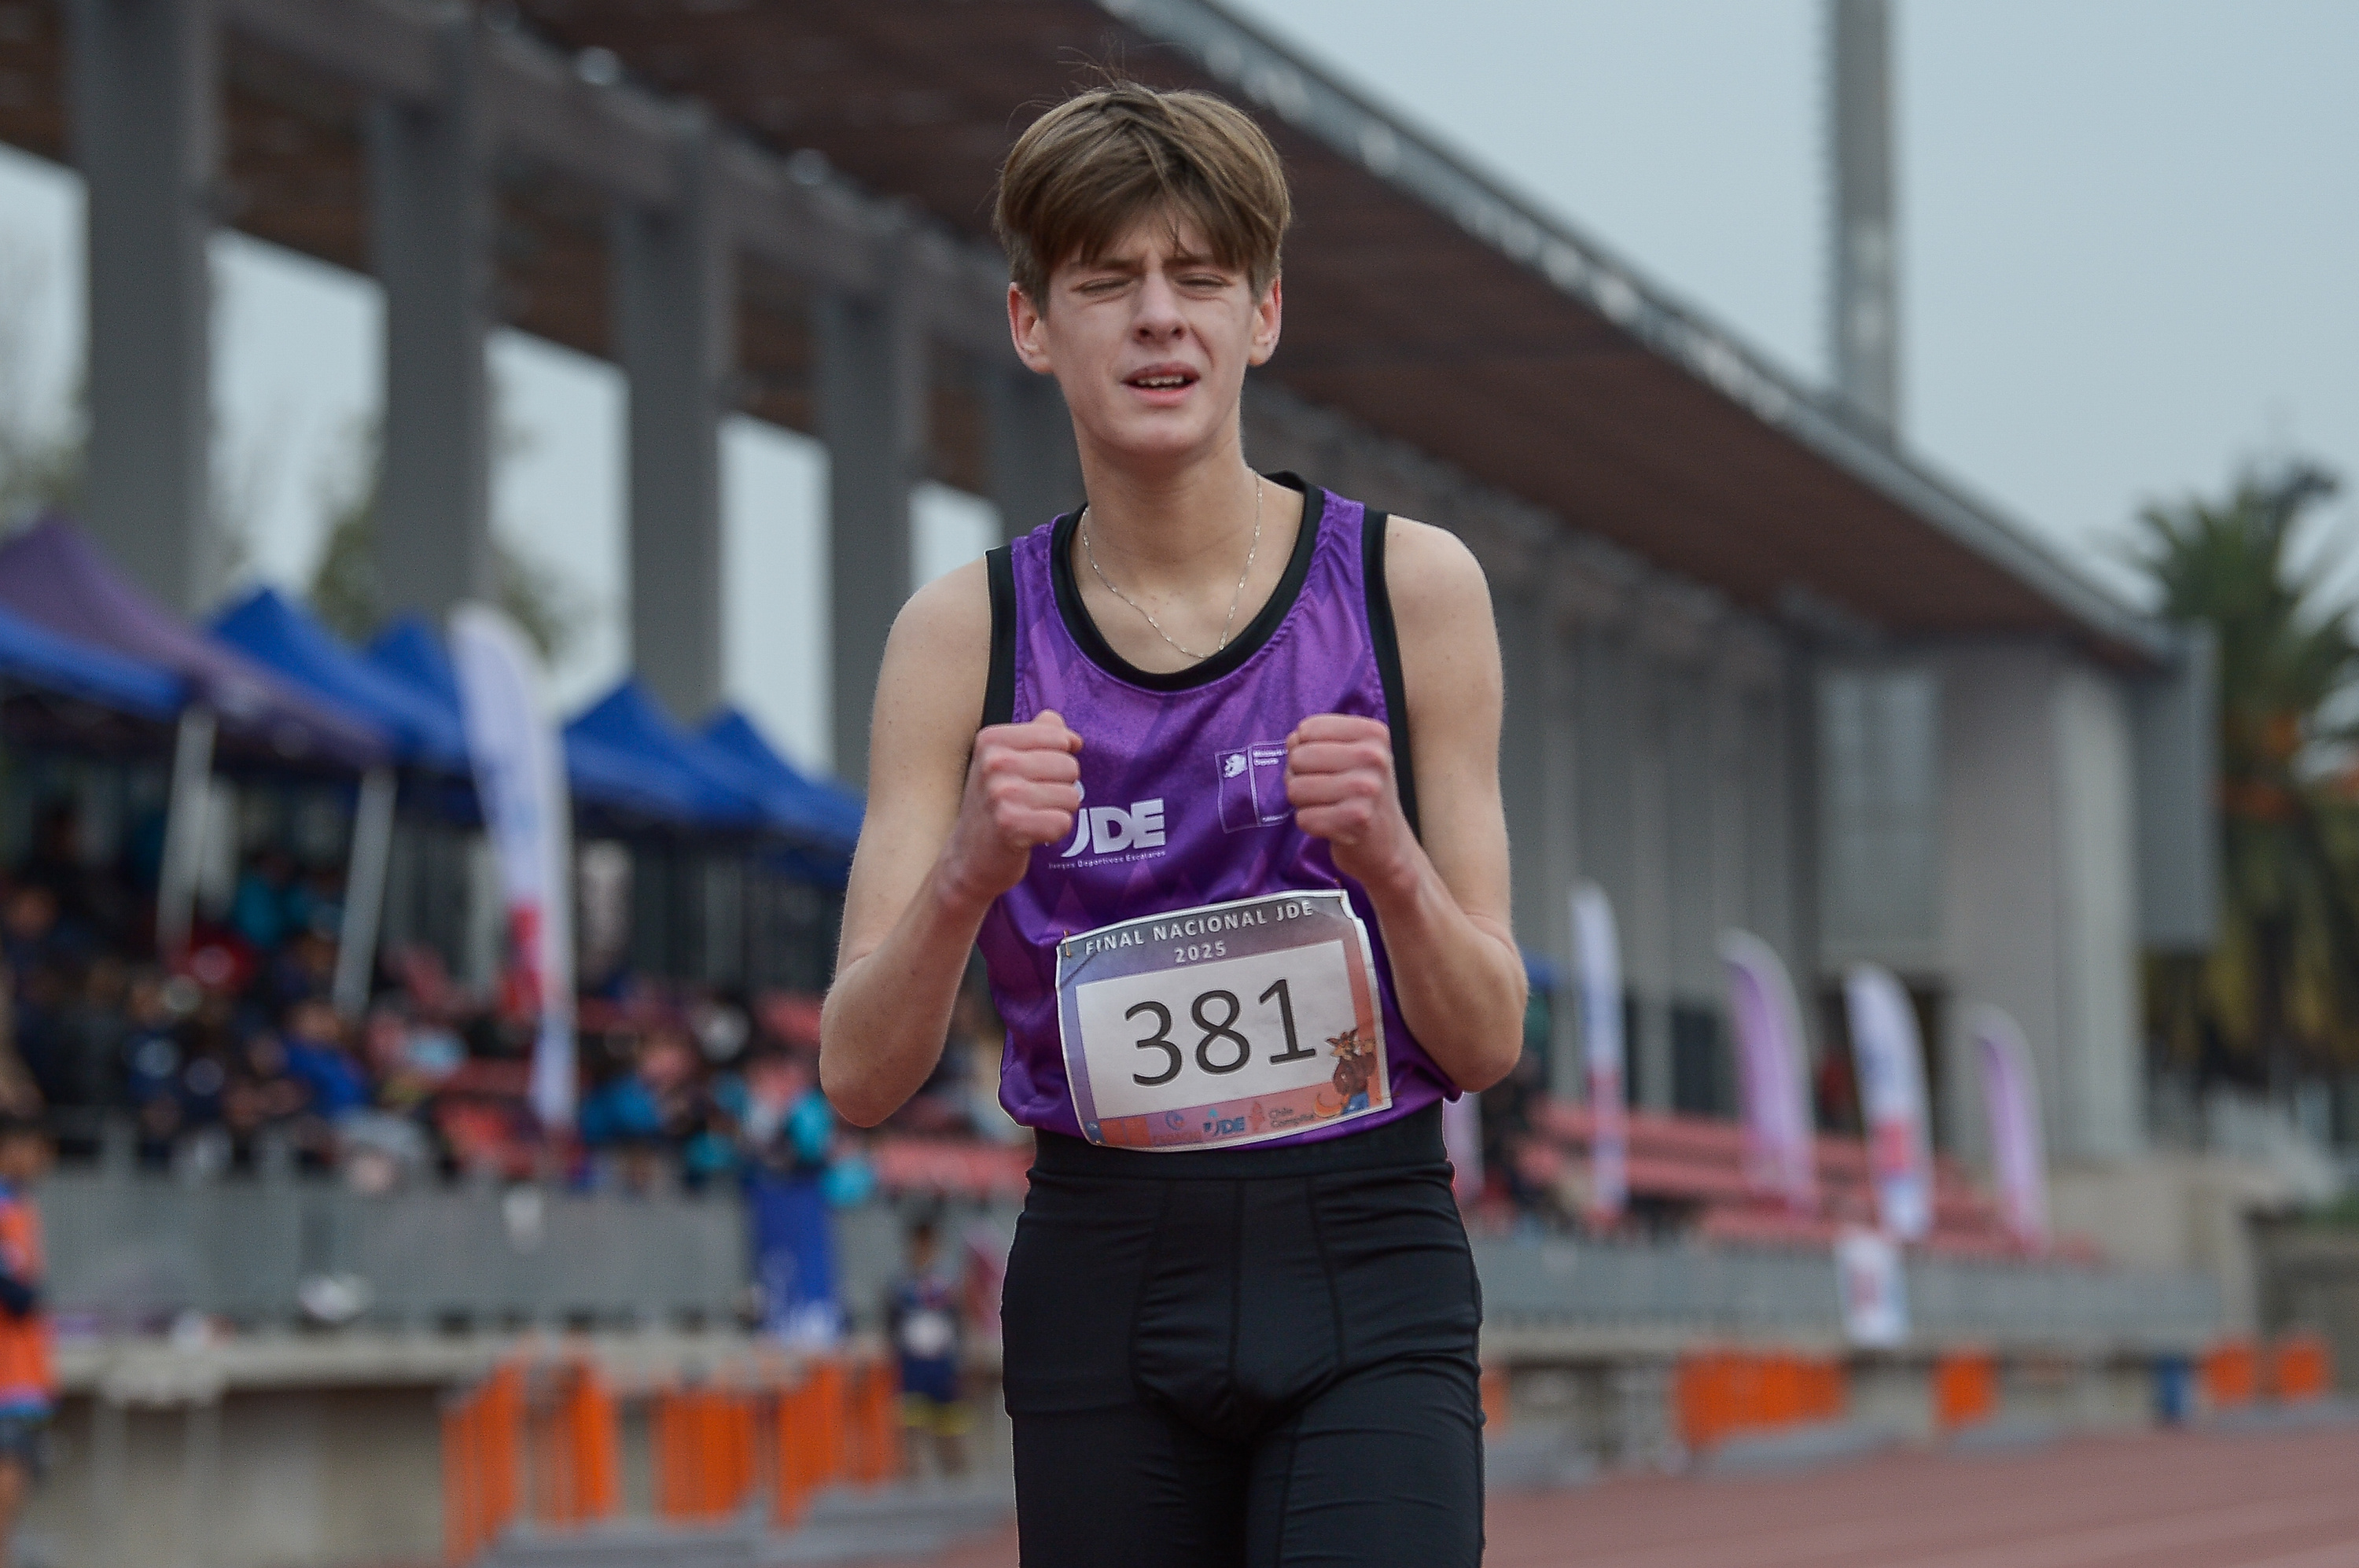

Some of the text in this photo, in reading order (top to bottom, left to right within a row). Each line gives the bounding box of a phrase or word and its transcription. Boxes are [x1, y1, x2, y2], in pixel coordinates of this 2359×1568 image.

[1061, 798, 1165, 857] JDE
[1077, 857, 1124, 867] Deportivos
[1085, 900, 1314, 955] FINAL NACIONAL JDE
[1175, 940, 1227, 963] 2025
[1125, 978, 1316, 1086] 381
